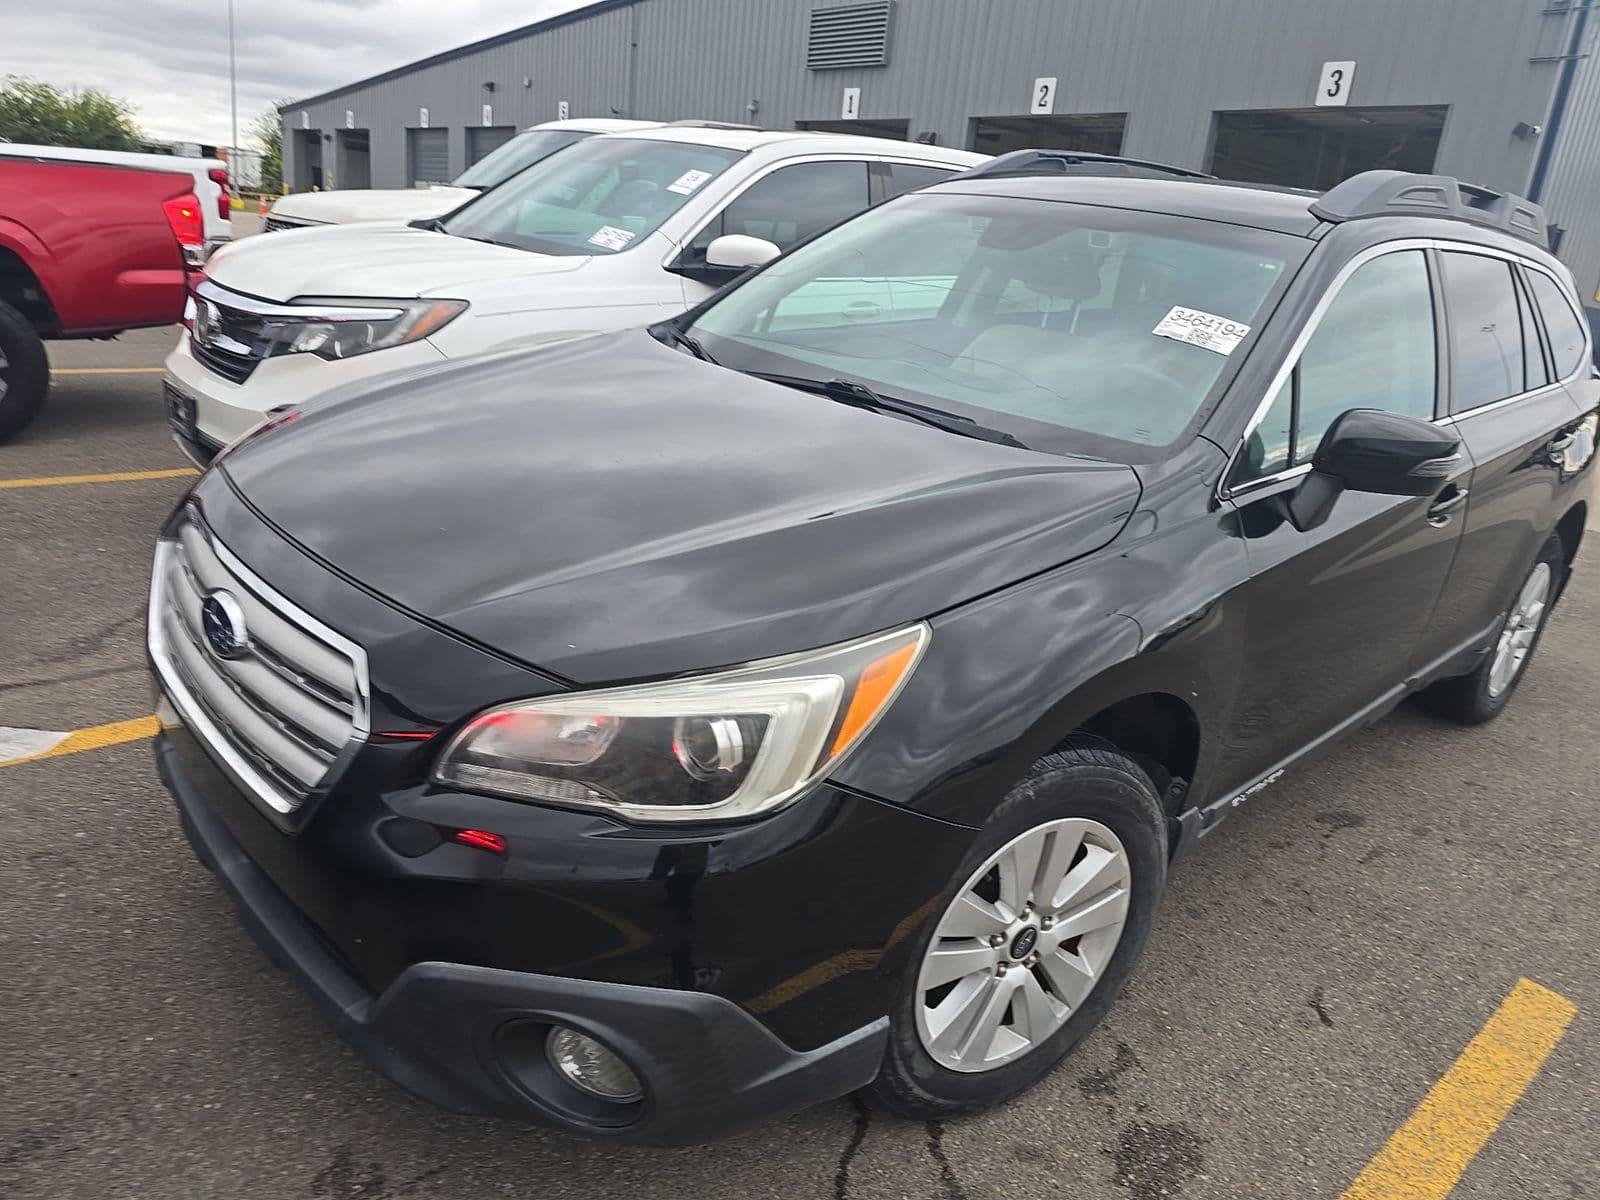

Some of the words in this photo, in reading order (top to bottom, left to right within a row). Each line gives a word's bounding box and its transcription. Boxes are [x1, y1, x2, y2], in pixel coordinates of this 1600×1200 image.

[1038, 85, 1049, 107] 2
[1327, 69, 1343, 97] 3
[1170, 310, 1246, 340] 3464194
